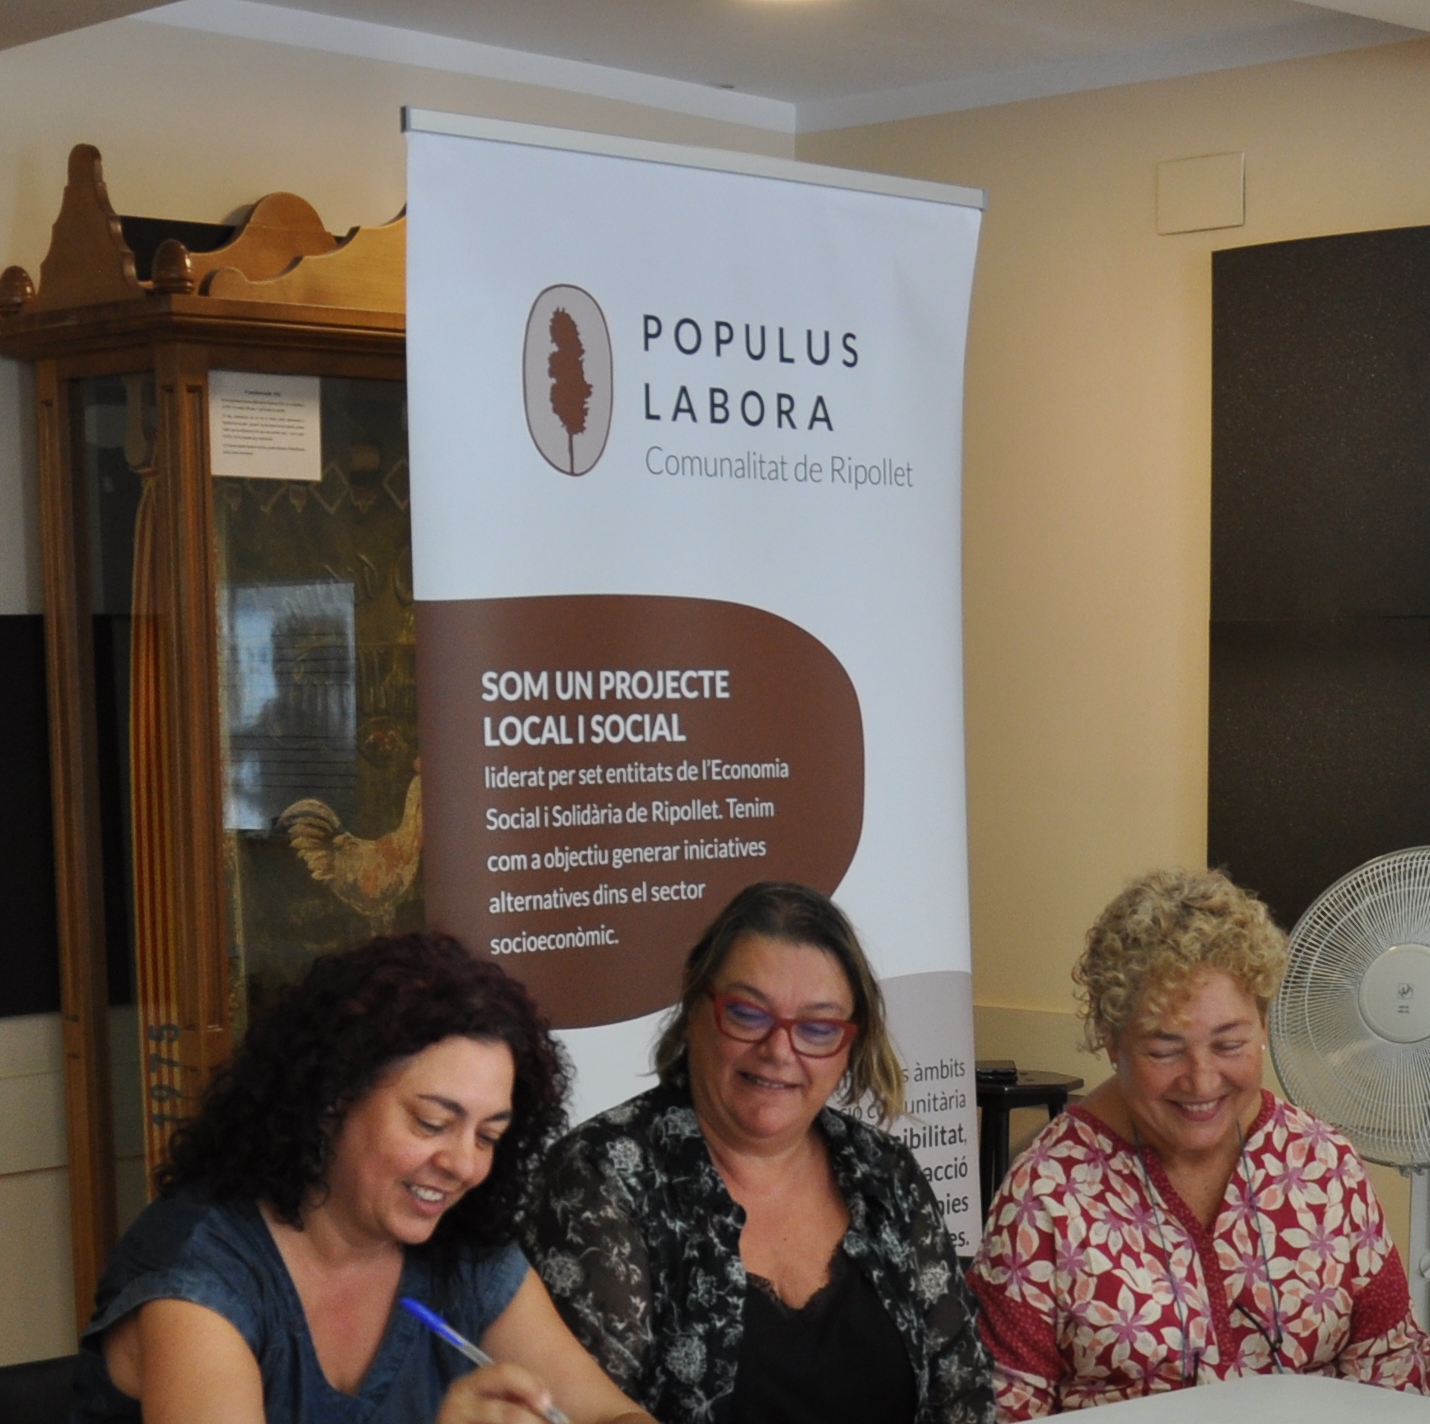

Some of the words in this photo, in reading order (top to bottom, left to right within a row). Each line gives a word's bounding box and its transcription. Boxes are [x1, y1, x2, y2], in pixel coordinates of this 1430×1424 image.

[642, 313, 859, 369] POPULUS
[643, 381, 834, 432] LABORA
[644, 445, 789, 482] Comunalitat
[793, 453, 823, 484] de
[830, 455, 914, 490] Ripollet
[481, 670, 549, 702] SOM
[555, 670, 593, 700] UN
[599, 669, 730, 700] PROJECTE
[483, 715, 573, 747] LOCAL
[578, 714, 585, 744] I
[590, 713, 686, 744] SOCIAL
[484, 765, 545, 789] liderat
[548, 767, 576, 790] per
[578, 764, 603, 785] set
[606, 762, 673, 784] entitats
[676, 759, 698, 782] de
[485, 806, 540, 831] Social
[543, 807, 549, 828] i
[552, 802, 622, 827] Solidària
[625, 801, 648, 824] de
[651, 799, 723, 825] Ripollet.
[725, 797, 775, 819] Tenim
[487, 854, 528, 872] com
[530, 853, 541, 870] a
[544, 844, 609, 872] objectiu
[612, 844, 680, 869] generar
[684, 836, 767, 860] iniciatives
[488, 887, 591, 914] alternatives
[593, 883, 629, 906] dins
[631, 880, 647, 903] el
[650, 880, 706, 902] sector
[490, 924, 620, 955] socioeconòmic.
[913, 1057, 965, 1083] àmbits
[897, 1123, 967, 1150] ibilitat,
